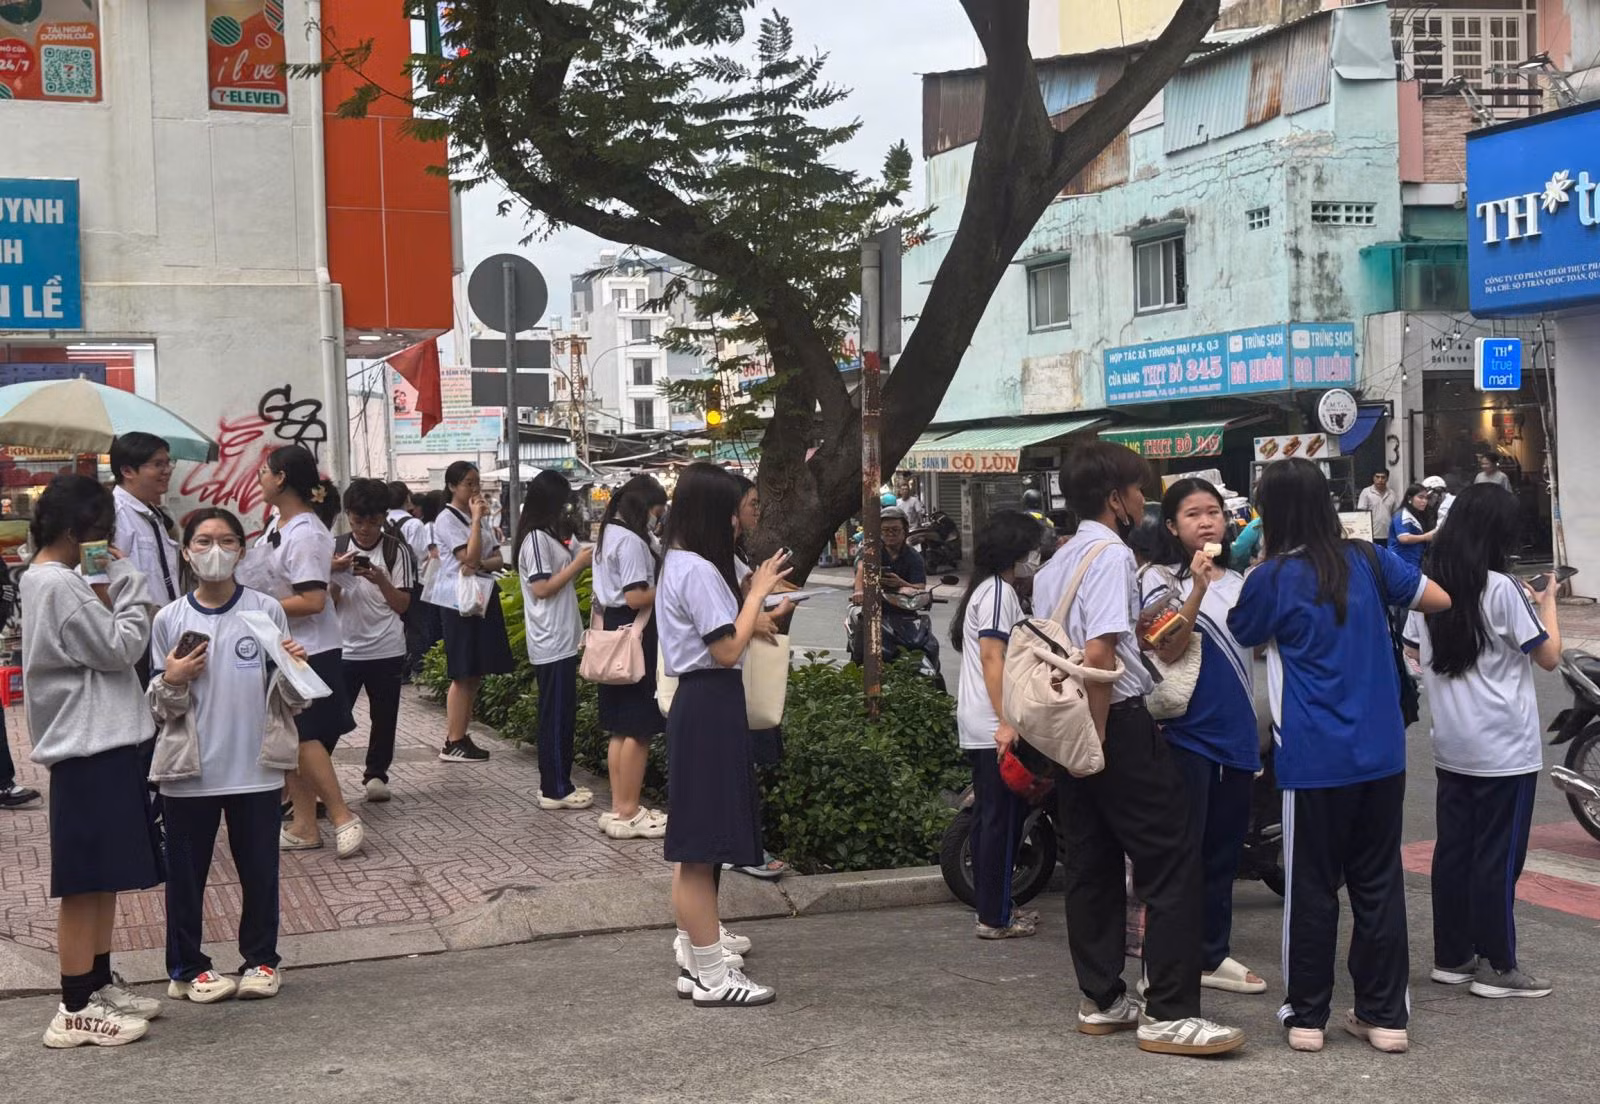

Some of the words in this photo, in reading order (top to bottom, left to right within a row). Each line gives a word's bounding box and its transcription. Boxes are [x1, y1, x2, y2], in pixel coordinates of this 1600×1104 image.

[40, 32, 94, 41] DOWNLOAD
[1476, 192, 1543, 244] TH
[1266, 331, 1283, 349] SẠCH
[1335, 330, 1353, 350] SẠCH
[1124, 349, 1136, 361] TÁC
[1148, 345, 1175, 358] THƯƠNG
[1492, 346, 1508, 357] TH
[1186, 355, 1222, 381] 345
[1491, 358, 1513, 370] true
[1488, 373, 1513, 385] mart
[1386, 434, 1400, 466] 3
[951, 452, 975, 470] CÔ
[981, 452, 1017, 470] LÙN
[65, 1016, 121, 1037] BOSTON
